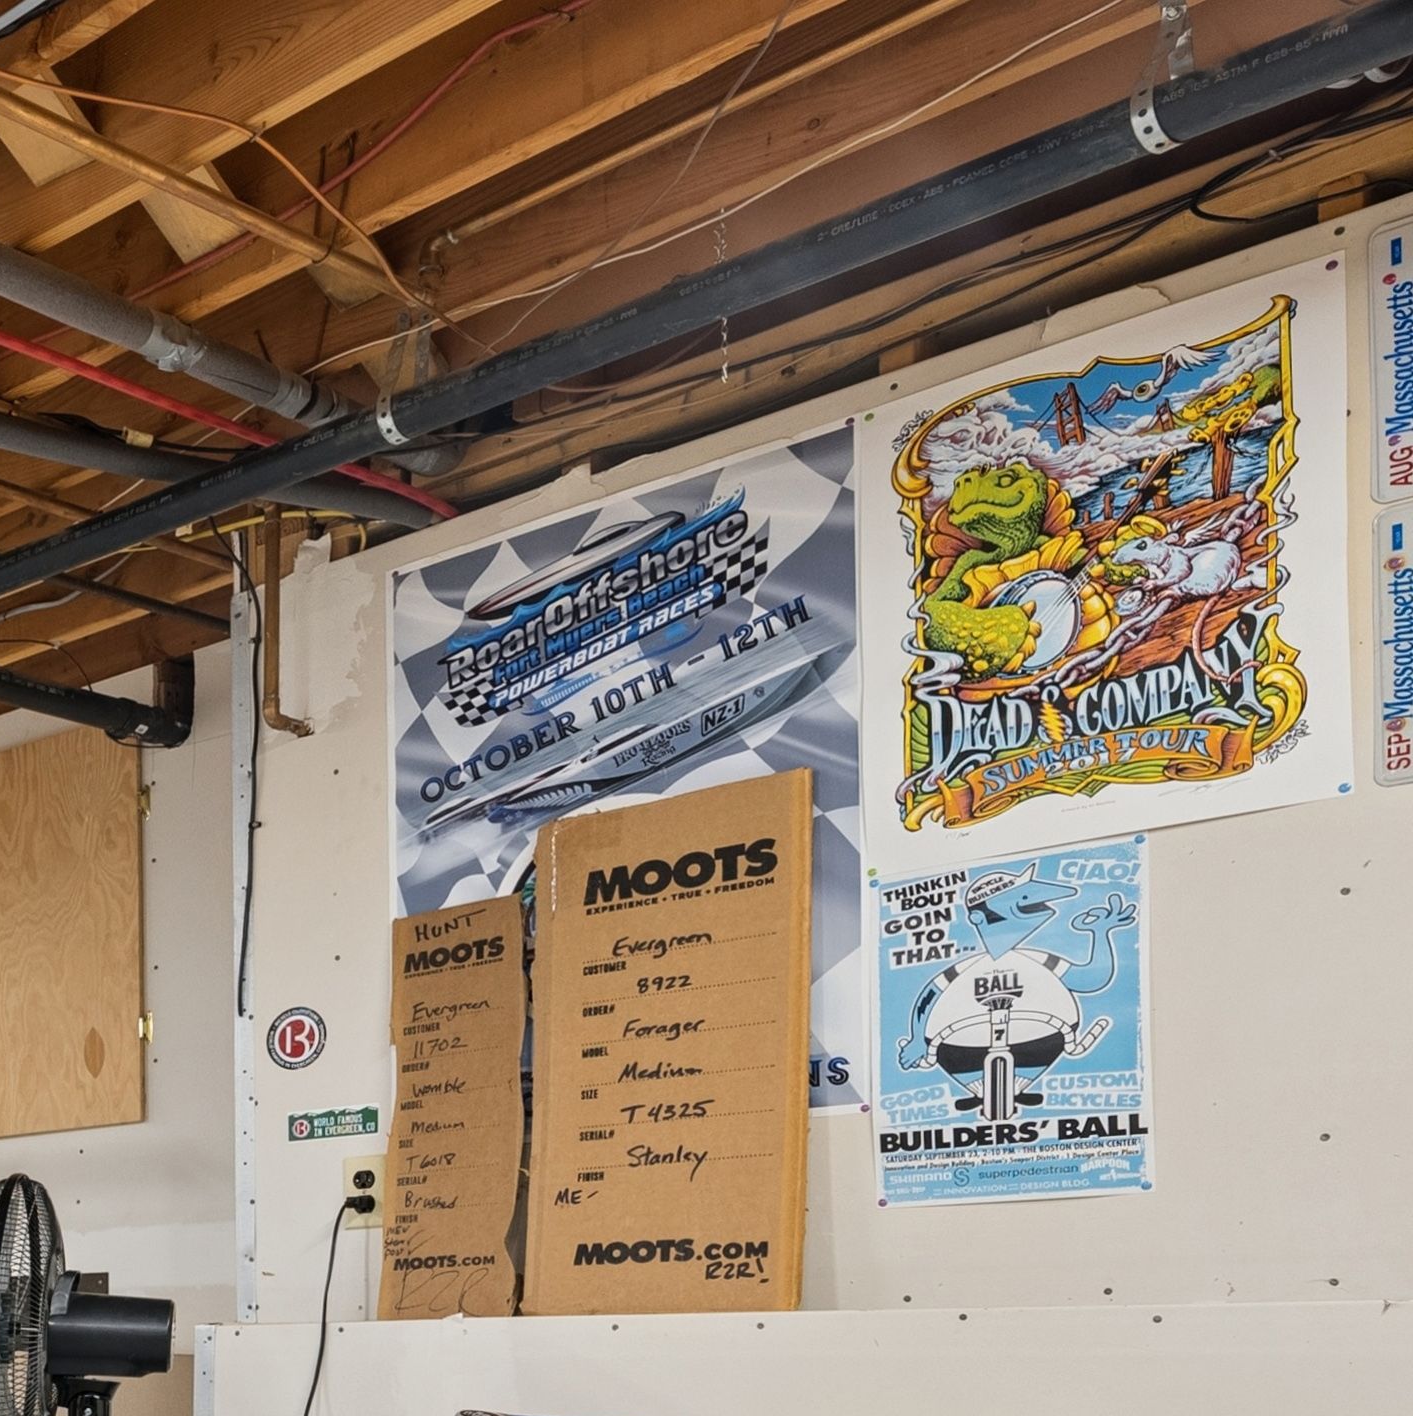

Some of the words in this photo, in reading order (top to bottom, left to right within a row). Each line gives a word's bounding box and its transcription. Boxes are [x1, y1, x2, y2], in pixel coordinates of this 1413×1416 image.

[1389, 445, 1413, 487] AUG
[492, 655, 542, 687] Fort
[545, 611, 621, 658] Myers
[626, 562, 708, 613] Beach
[493, 626, 636, 708] POWERBOAT
[637, 584, 719, 637] RACES
[420, 708, 582, 803] OCTOBER
[590, 661, 678, 724] 10TH
[717, 593, 813, 662] 12TH
[923, 688, 1033, 780] DEAD
[1076, 605, 1275, 735] COMPANY
[703, 697, 742, 733] NZ-1
[980, 736, 1108, 797] SUMMER
[1111, 727, 1211, 758] TOUR
[1043, 747, 1141, 778] 2017
[1387, 733, 1411, 772] SEP
[583, 837, 779, 907] MOOTS
[585, 896, 659, 916] EXPERIENCE
[670, 888, 703, 902] TRUE
[713, 875, 776, 895] FREEDOM
[882, 870, 968, 904] THINKIN
[900, 889, 958, 912] BOUT
[414, 908, 487, 943] HUNT
[883, 907, 953, 935] GOIN
[611, 932, 714, 960] Evergreen
[911, 928, 946, 946] TO
[403, 935, 506, 975] MOOTS
[404, 967, 444, 980] EXPERIENCE
[449, 964, 466, 972] TRUE
[471, 957, 504, 967] FREEDOM
[582, 960, 628, 977] CUSTOMER
[636, 974, 694, 995] 8922
[974, 972, 1024, 997] BALL
[411, 998, 491, 1023] Evergreen
[582, 1003, 616, 1018] ORDER#
[402, 1021, 441, 1037] CUSTOMER
[622, 1018, 706, 1042] Forager
[993, 1028, 1005, 1042] 7
[581, 1046, 610, 1059] MODEL
[617, 1061, 704, 1084] Medium
[1044, 1071, 1139, 1092] CUSTOM
[399, 1099, 424, 1112] MODEL
[580, 1089, 599, 1100] SIZE
[879, 1085, 947, 1112] GOOD
[1045, 1091, 1143, 1109] BICYCLES
[313, 1115, 336, 1127] WORLD
[337, 1113, 364, 1125] FAMOUS
[887, 1104, 950, 1124] TIMES
[314, 1127, 323, 1138] IN
[366, 1122, 376, 1132] CO
[410, 1120, 466, 1135] Medium
[578, 1129, 616, 1142] SERIAL#
[879, 1119, 1050, 1155] BUILDERS'
[1057, 1113, 1149, 1141] BALL
[398, 1139, 415, 1150] SIZE
[885, 1152, 922, 1164] SATURDAY
[924, 1150, 966, 1161] SEPTEMBER
[1022, 1145, 1037, 1154] THE
[1039, 1142, 1073, 1152] BOSTON
[1074, 1139, 1104, 1150] DESIGN
[626, 1144, 709, 1184] Stanley
[978, 1163, 1079, 1180] superpedestrian
[396, 1176, 429, 1188] SERIAL#
[577, 1171, 605, 1184] FINISH
[943, 1183, 1007, 1195] INNOVATION
[1020, 1179, 1059, 1191] DESIGN
[394, 1213, 419, 1225] FINISH
[392, 1253, 496, 1273] MOOTS.COM
[573, 1237, 770, 1267] MOOTS.COM
